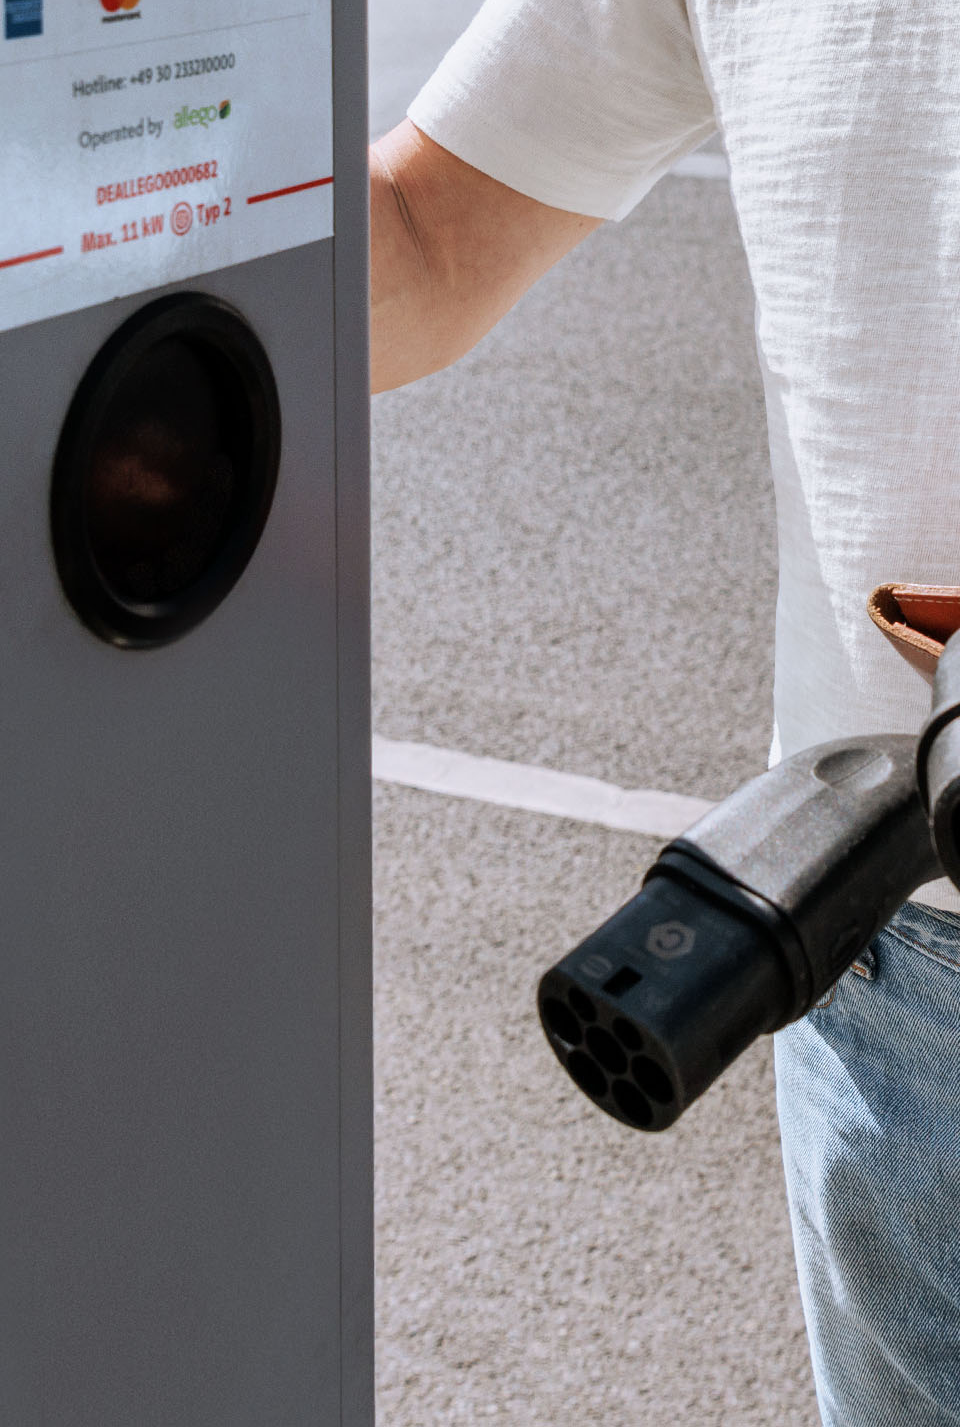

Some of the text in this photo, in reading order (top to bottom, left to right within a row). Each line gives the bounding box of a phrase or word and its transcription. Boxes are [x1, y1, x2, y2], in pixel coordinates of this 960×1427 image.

[72, 75, 127, 98] Hotline:
[130, 68, 153, 86] +49
[156, 65, 171, 83] 30
[79, 104, 218, 151] Operated by allego
[81, 197, 232, 254] Max. 11 kW Typ 2
